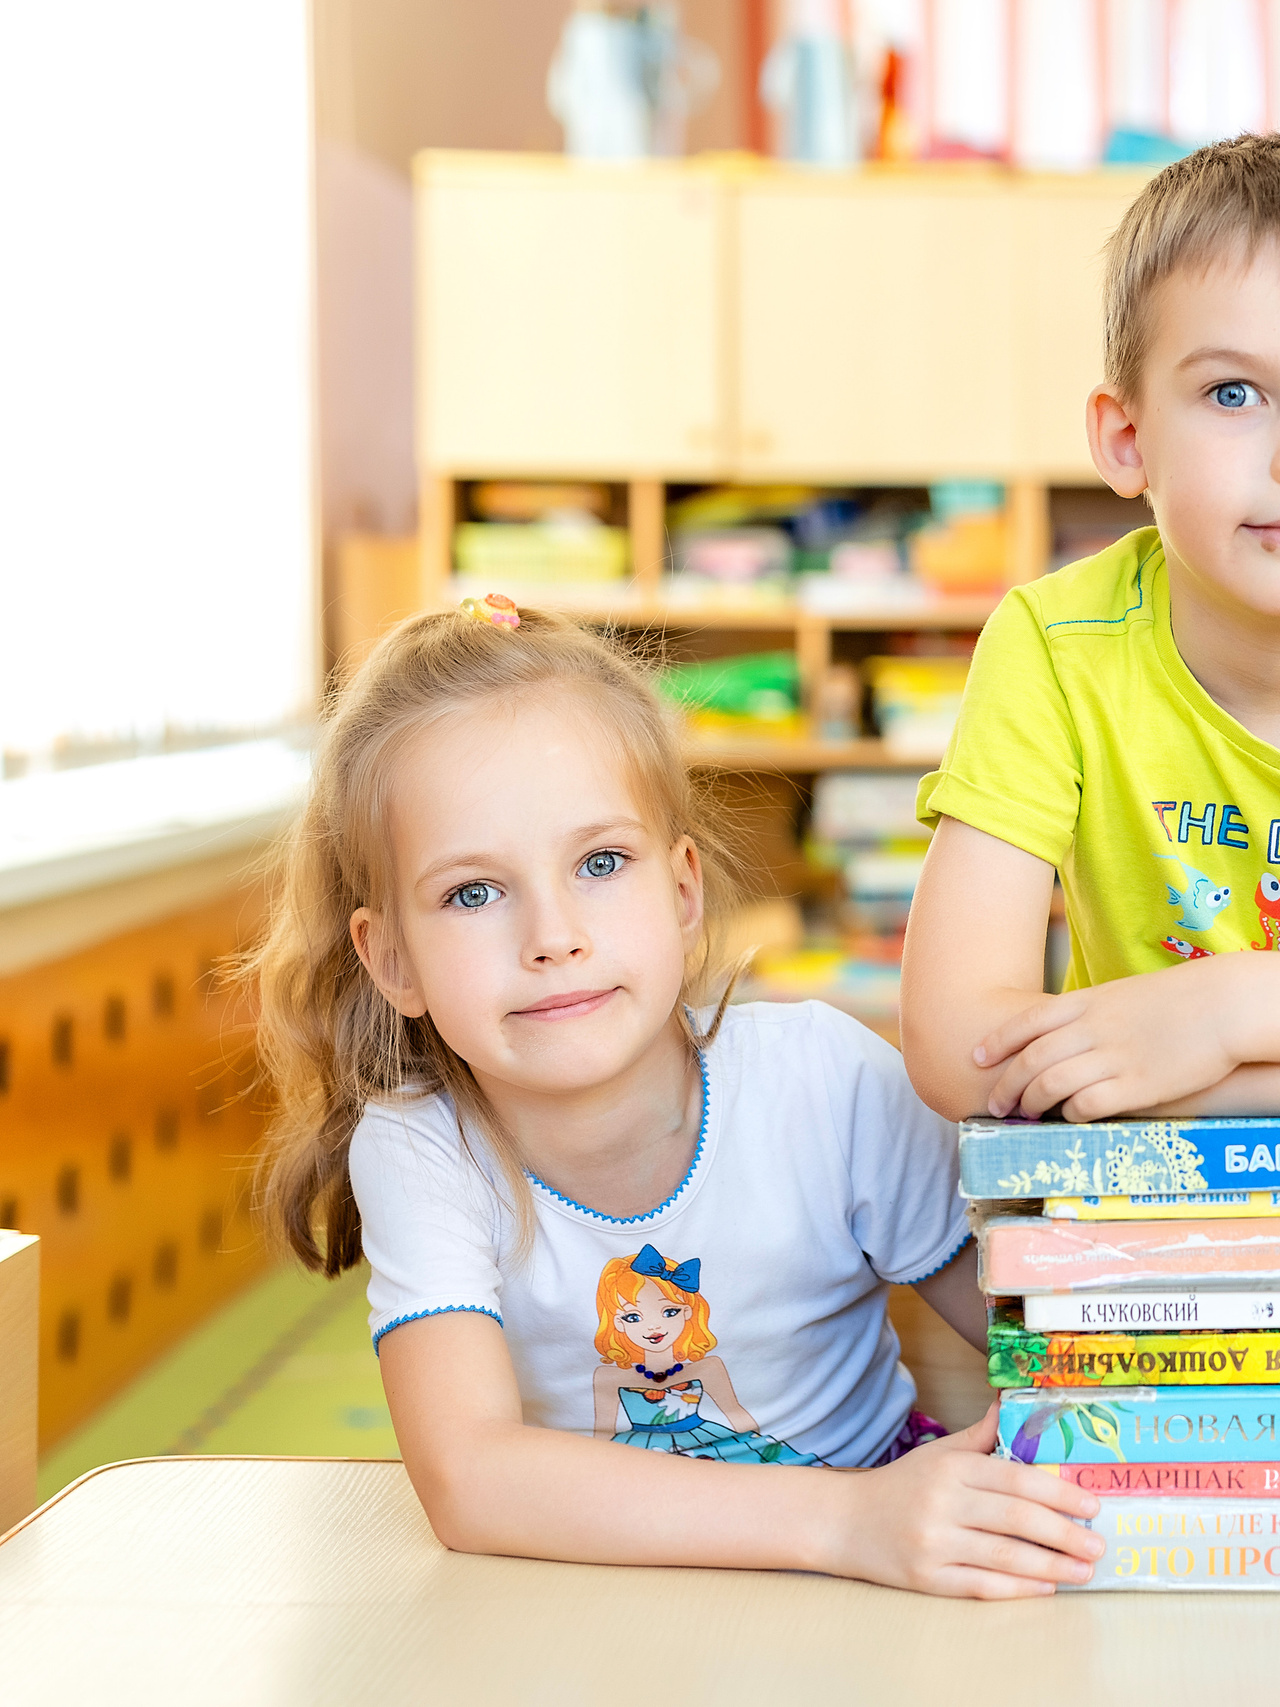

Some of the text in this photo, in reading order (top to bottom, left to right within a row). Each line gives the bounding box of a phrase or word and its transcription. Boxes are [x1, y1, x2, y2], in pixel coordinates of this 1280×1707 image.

[1152, 801, 1249, 849] THE
[1012, 1347, 1249, 1376] ДОШКОЛЬНИКА
[1134, 1413, 1276, 1445] НОВАЯ
[1107, 1468, 1246, 1490] МАРШАК
[1115, 1512, 1205, 1537] КОГДА
[1214, 1512, 1264, 1538] ГДЕ
[1114, 1545, 1196, 1578] ЭТО
